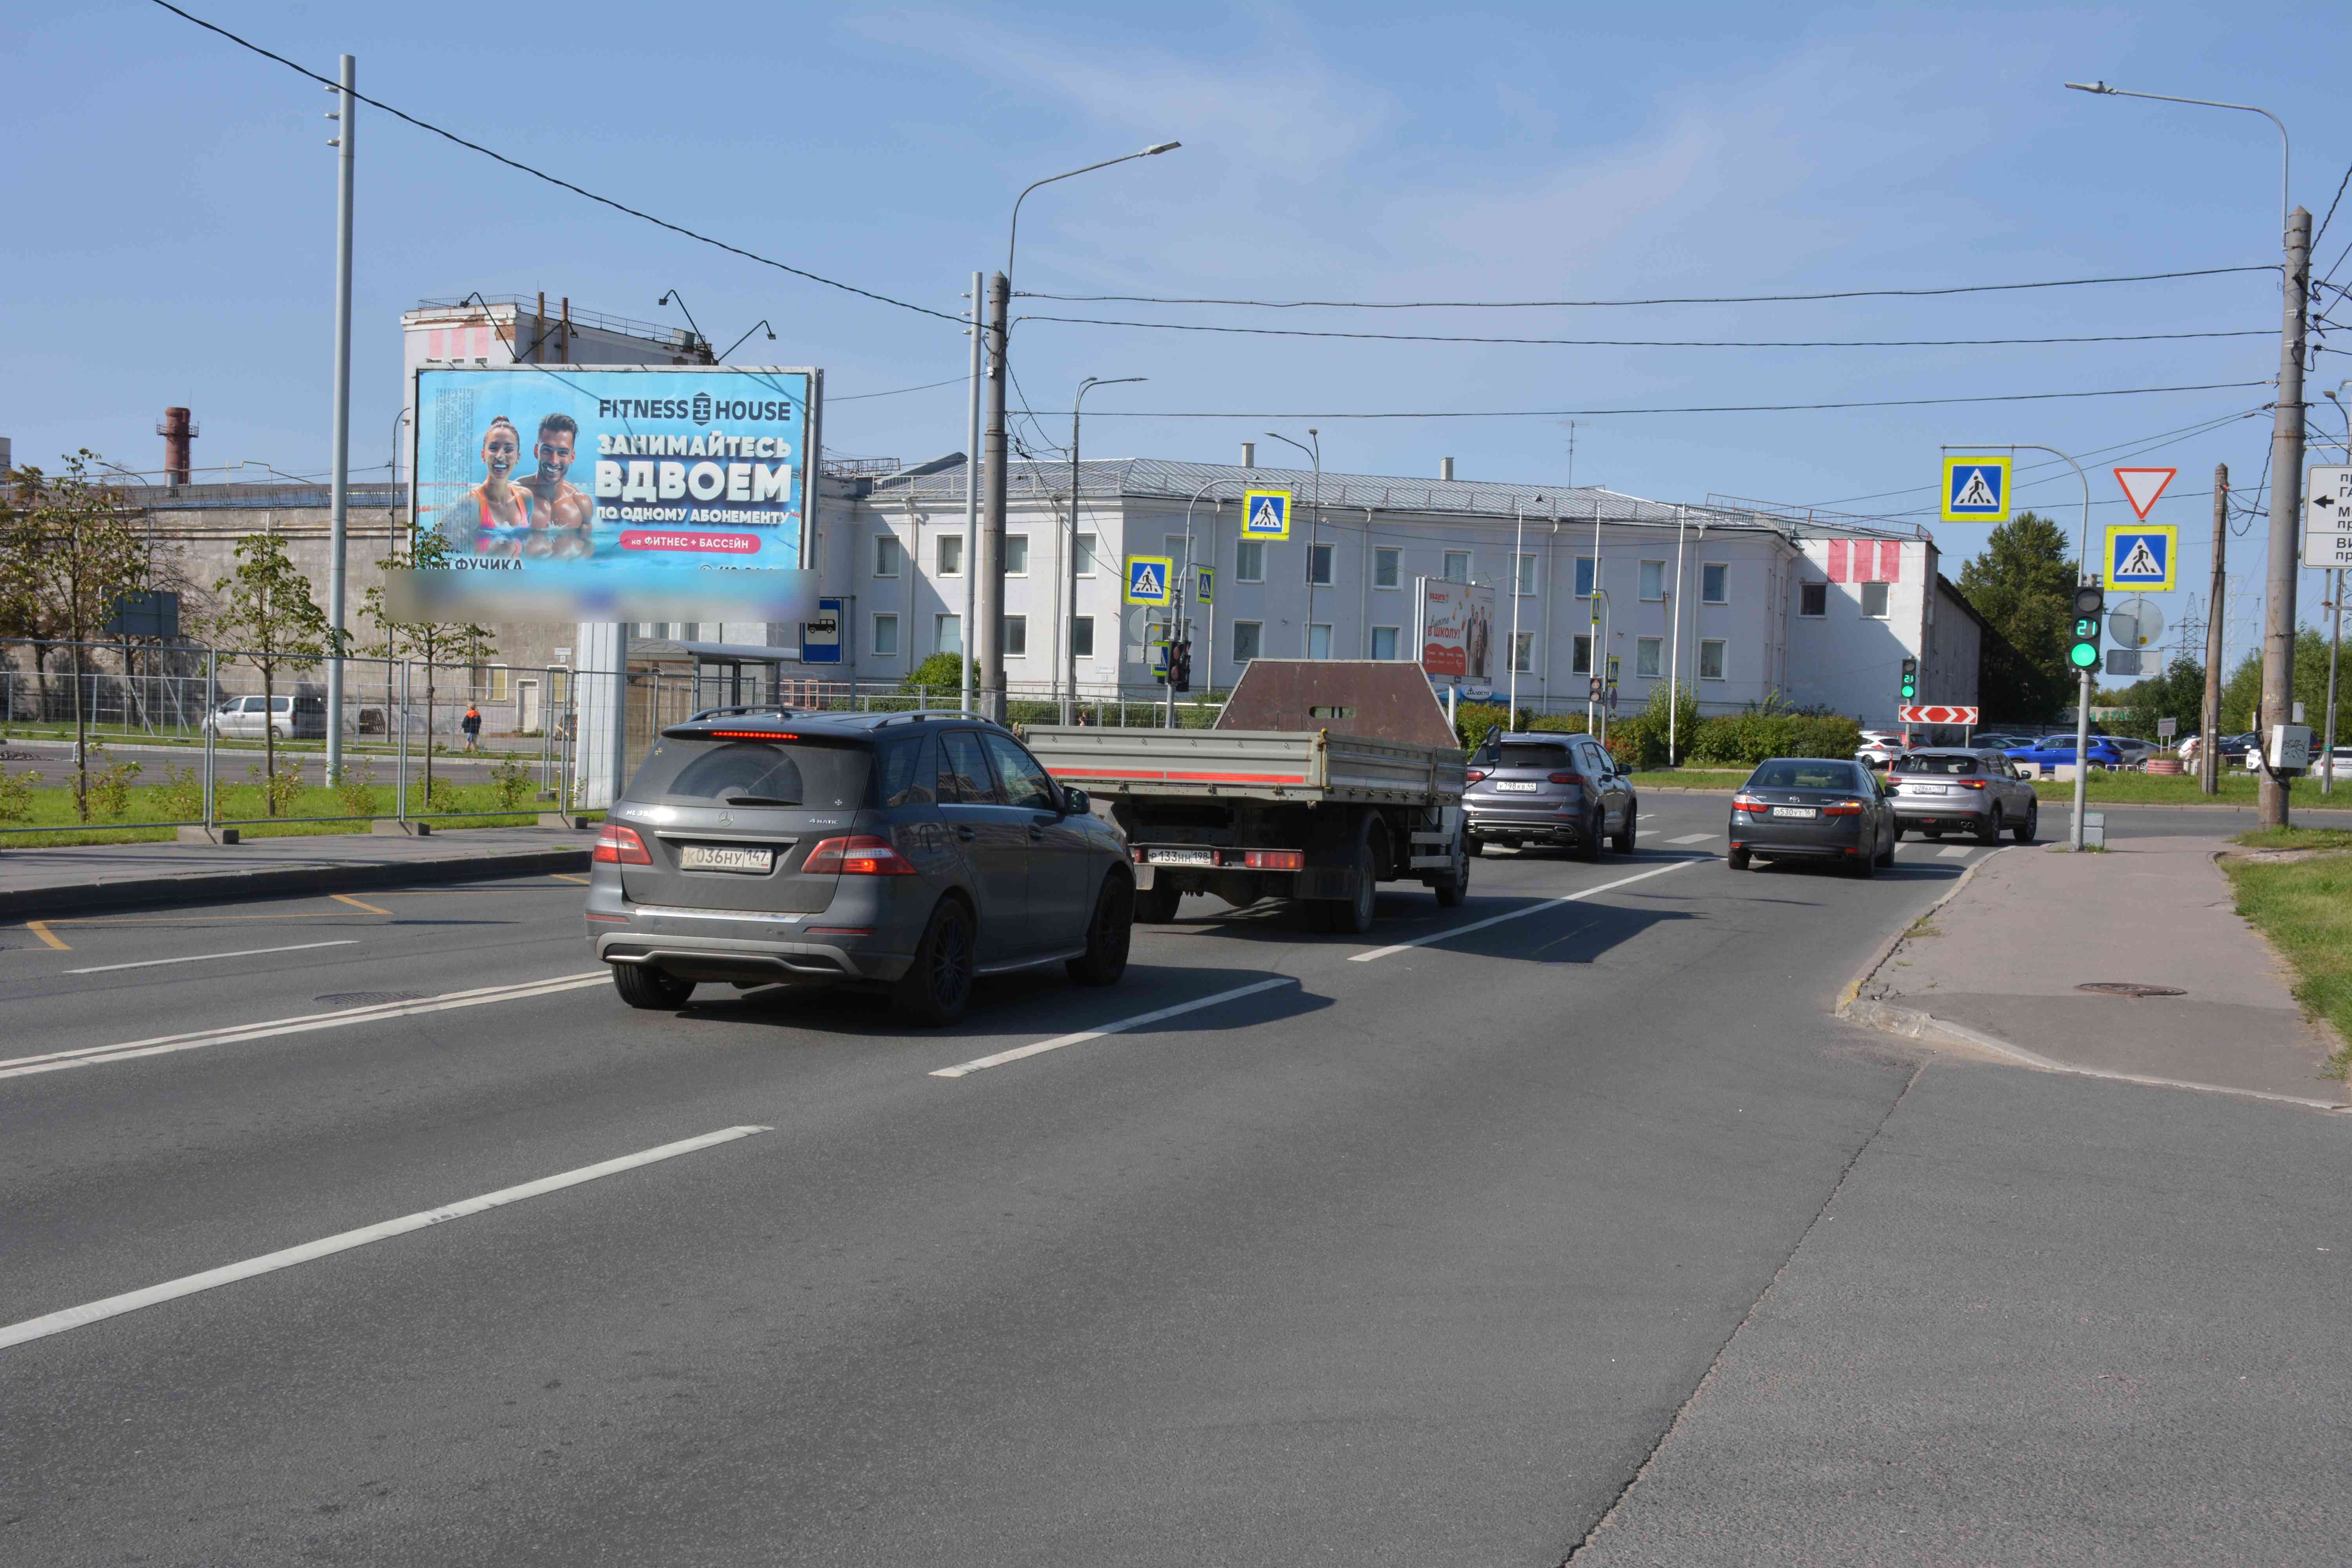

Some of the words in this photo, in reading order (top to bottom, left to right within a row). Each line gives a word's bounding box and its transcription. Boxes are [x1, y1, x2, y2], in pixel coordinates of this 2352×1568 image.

[599, 399, 688, 419] FITNESS
[716, 401, 791, 421] HOUSE
[596, 430, 792, 458] ЗАНИМАЙТЕСЬ
[595, 460, 792, 503] ВДВОЕМ
[595, 506, 619, 519] ПО
[621, 507, 687, 522] ОДНОМУ
[690, 509, 790, 524] АБОНЕМЕНТУ
[644, 536, 688, 547] ФИТНЕС
[699, 537, 749, 549] БАССЕЙН
[455, 557, 522, 570] ФУЧИКА
[1434, 626, 1460, 639] ШКОЛУ!
[2078, 620, 2096, 635] 21
[686, 848, 742, 865] К036НУ
[746, 849, 768, 862] 147
[1151, 851, 1191, 862] Р133НН
[1193, 851, 1208, 860] 198
